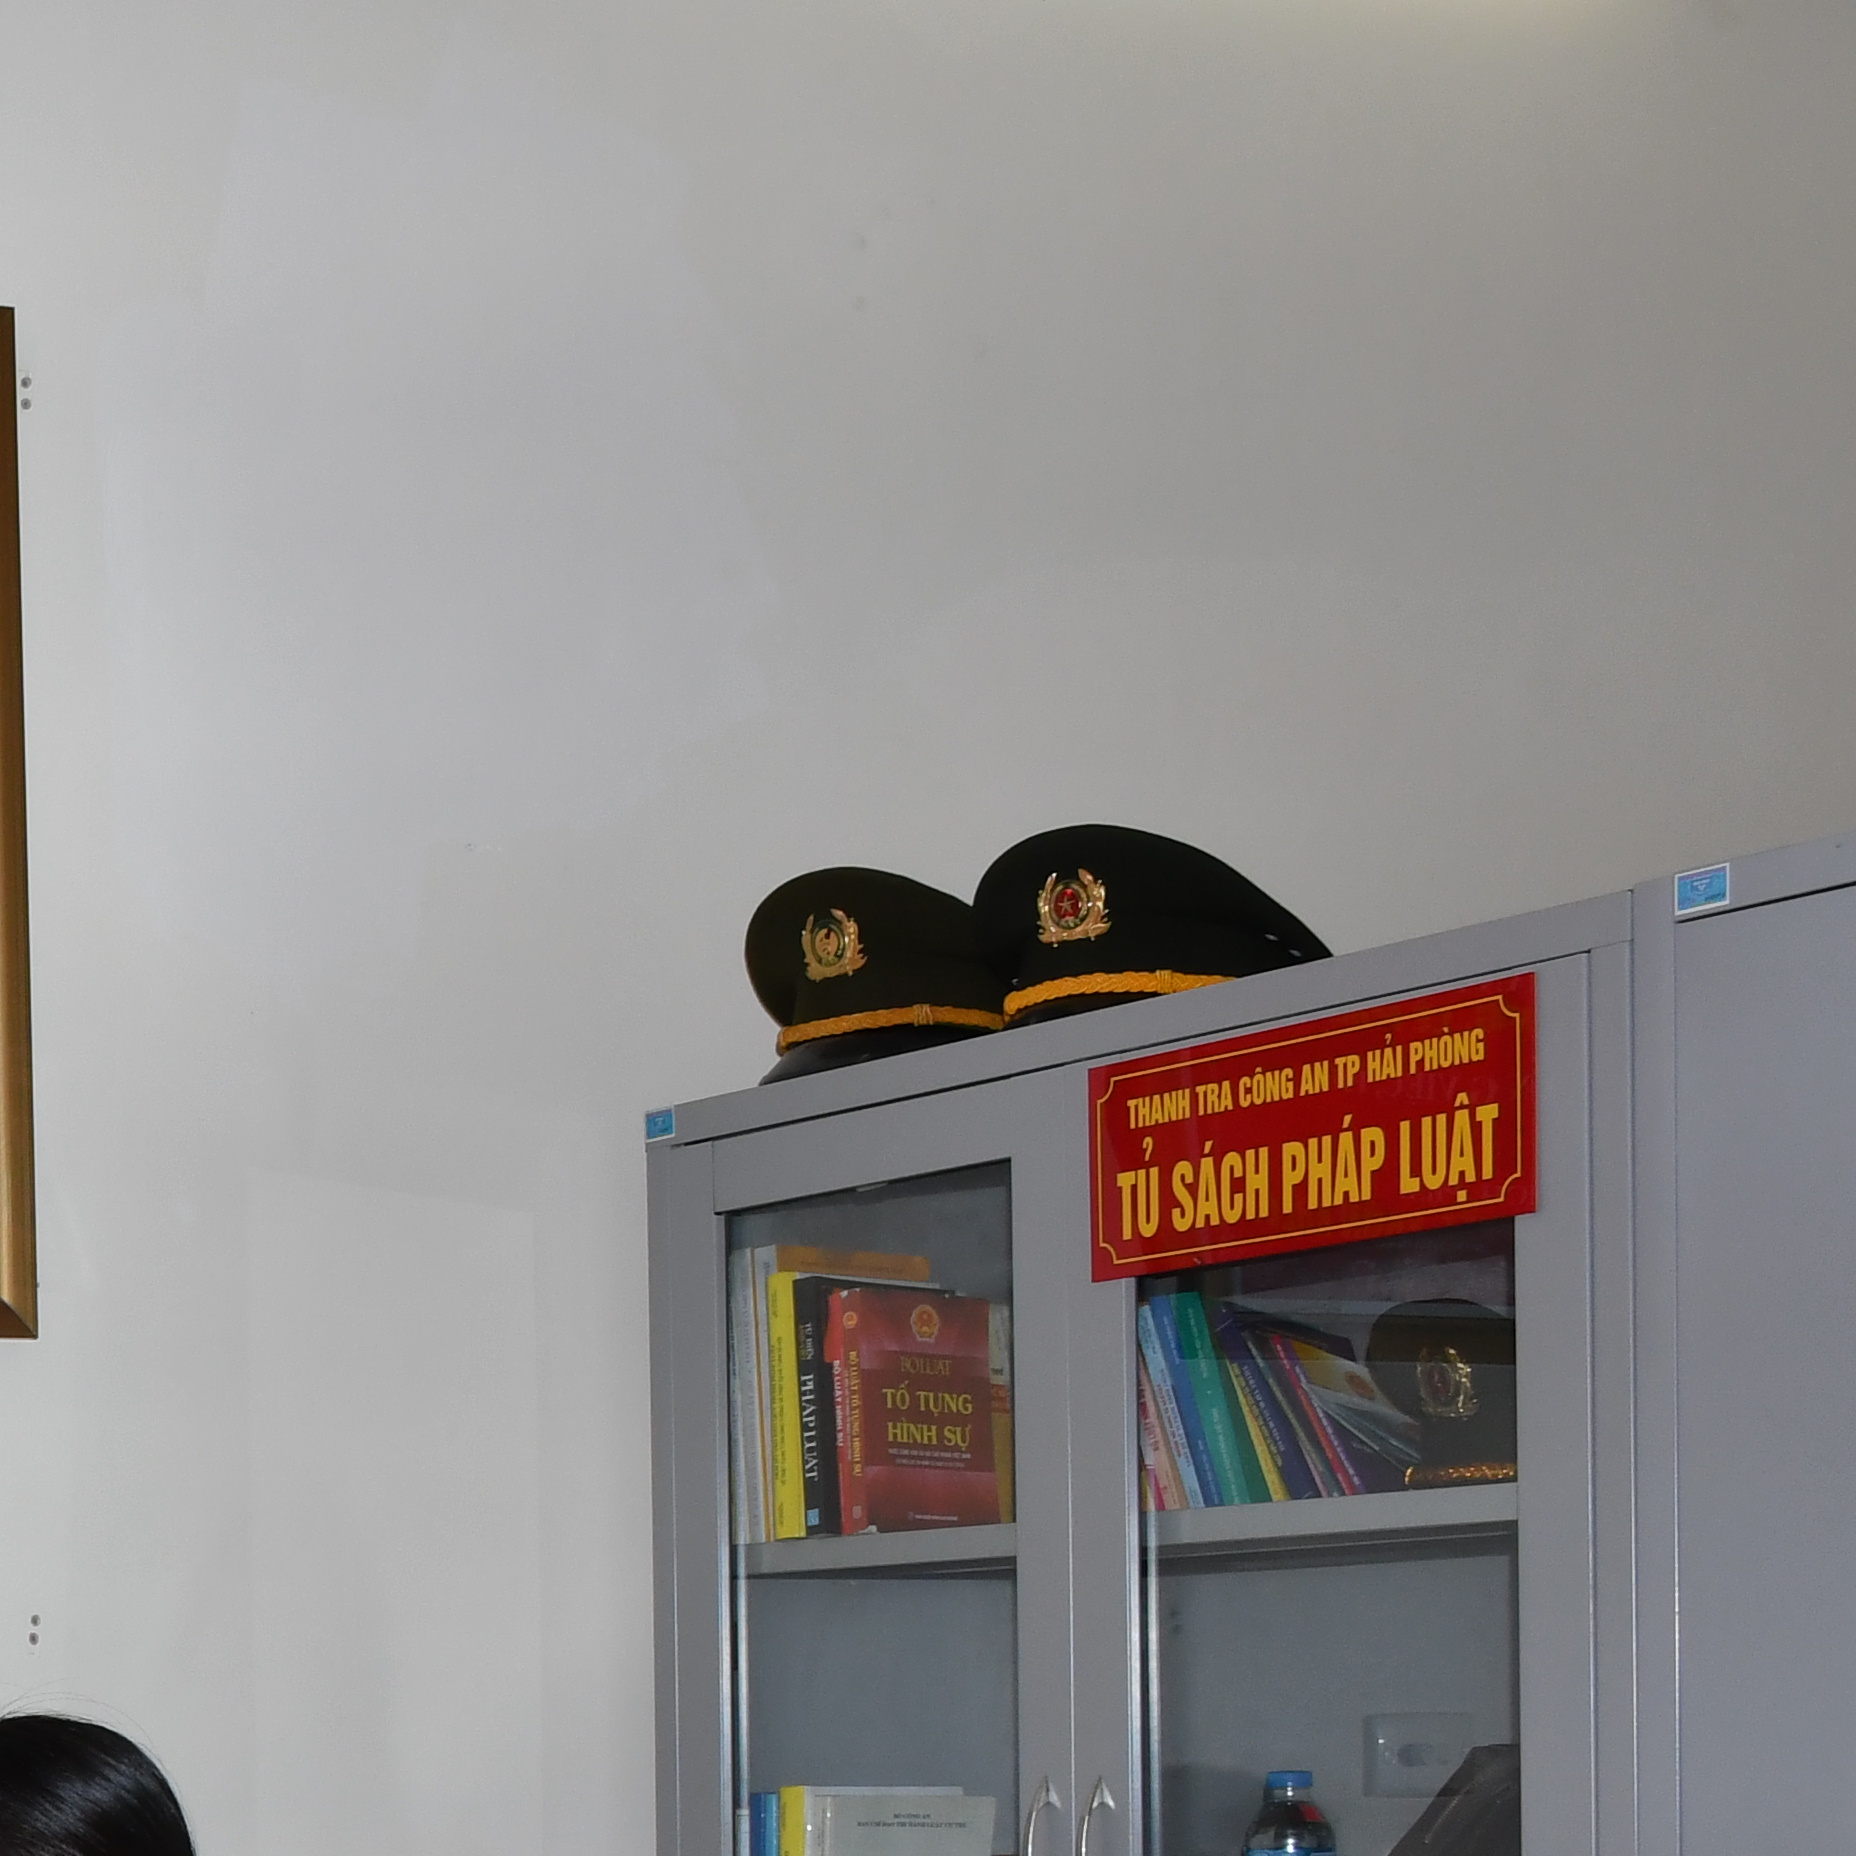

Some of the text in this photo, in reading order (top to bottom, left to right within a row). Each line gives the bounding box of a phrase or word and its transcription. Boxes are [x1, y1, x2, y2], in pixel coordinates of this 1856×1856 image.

[1127, 1026, 1485, 1130] THANH TRA CÔNG AN TP HẢI PHÒNG
[1116, 1091, 1499, 1241] TỦ SÁCH PHÁP LUẬT
[881, 1379, 973, 1417] TỐ TỤNG
[887, 1417, 972, 1451] HÌNH SỰ
